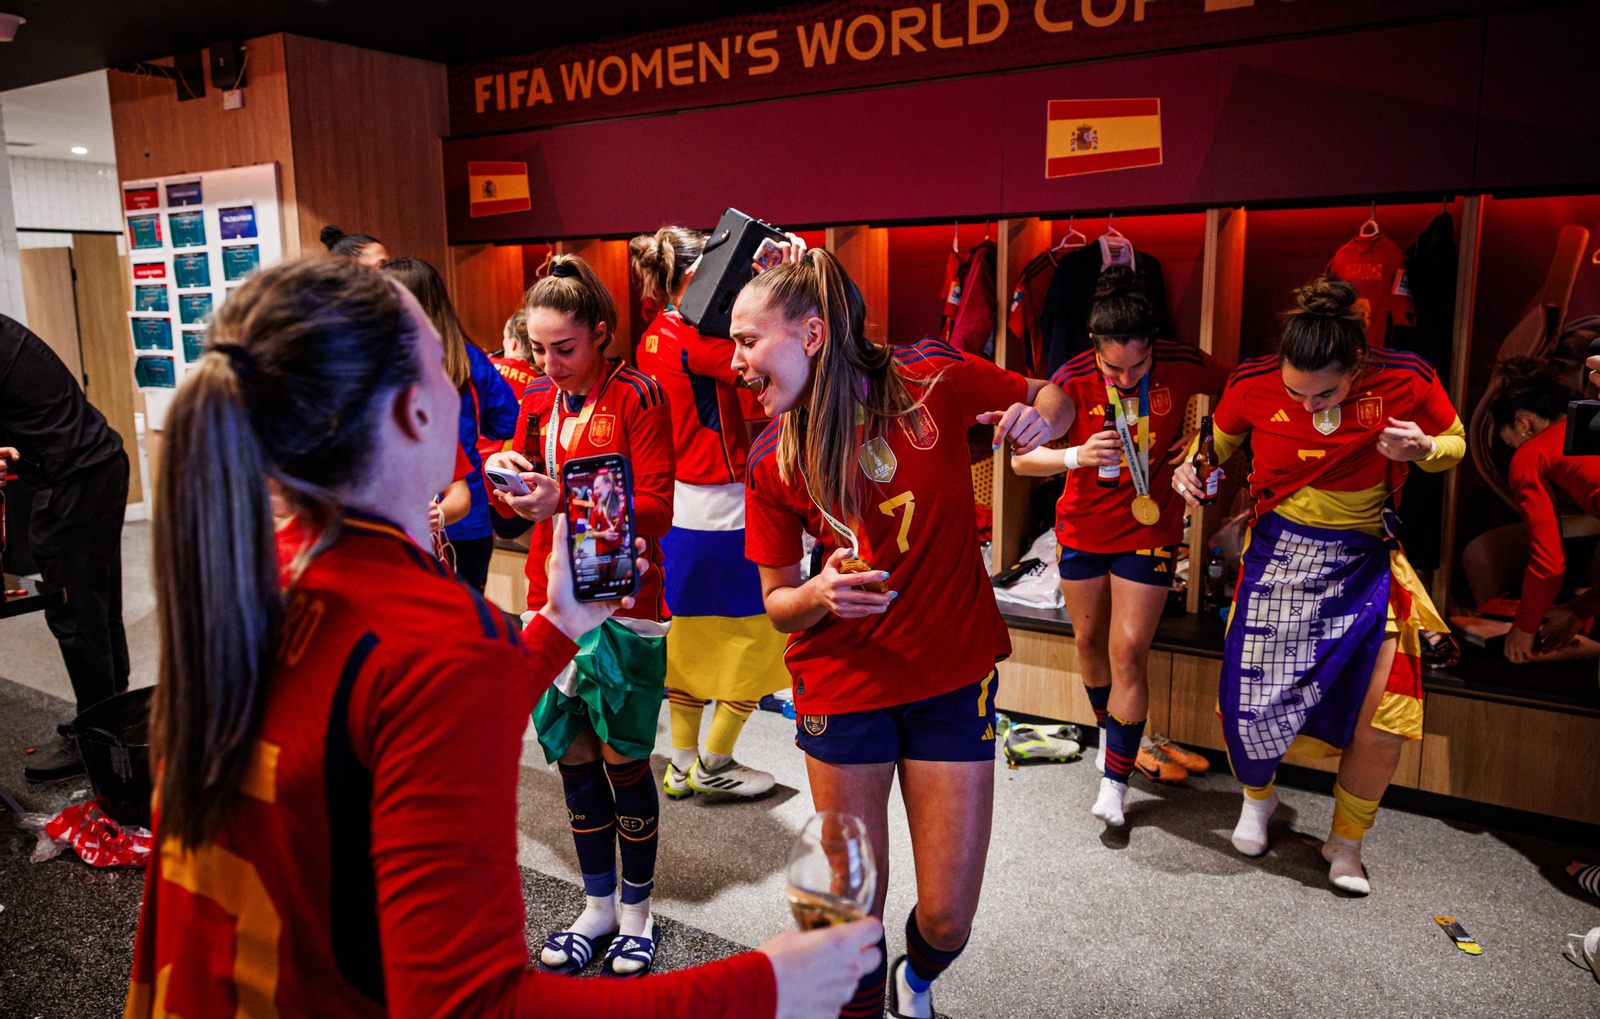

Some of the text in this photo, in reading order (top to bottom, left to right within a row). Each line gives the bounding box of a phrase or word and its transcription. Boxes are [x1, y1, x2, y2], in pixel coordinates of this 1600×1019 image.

[474, 68, 553, 113] FIFA
[560, 30, 780, 101] WOMEN'S
[796, 0, 1010, 68] WORLD
[874, 463, 890, 475] FIFA
[878, 490, 916, 553] 7
